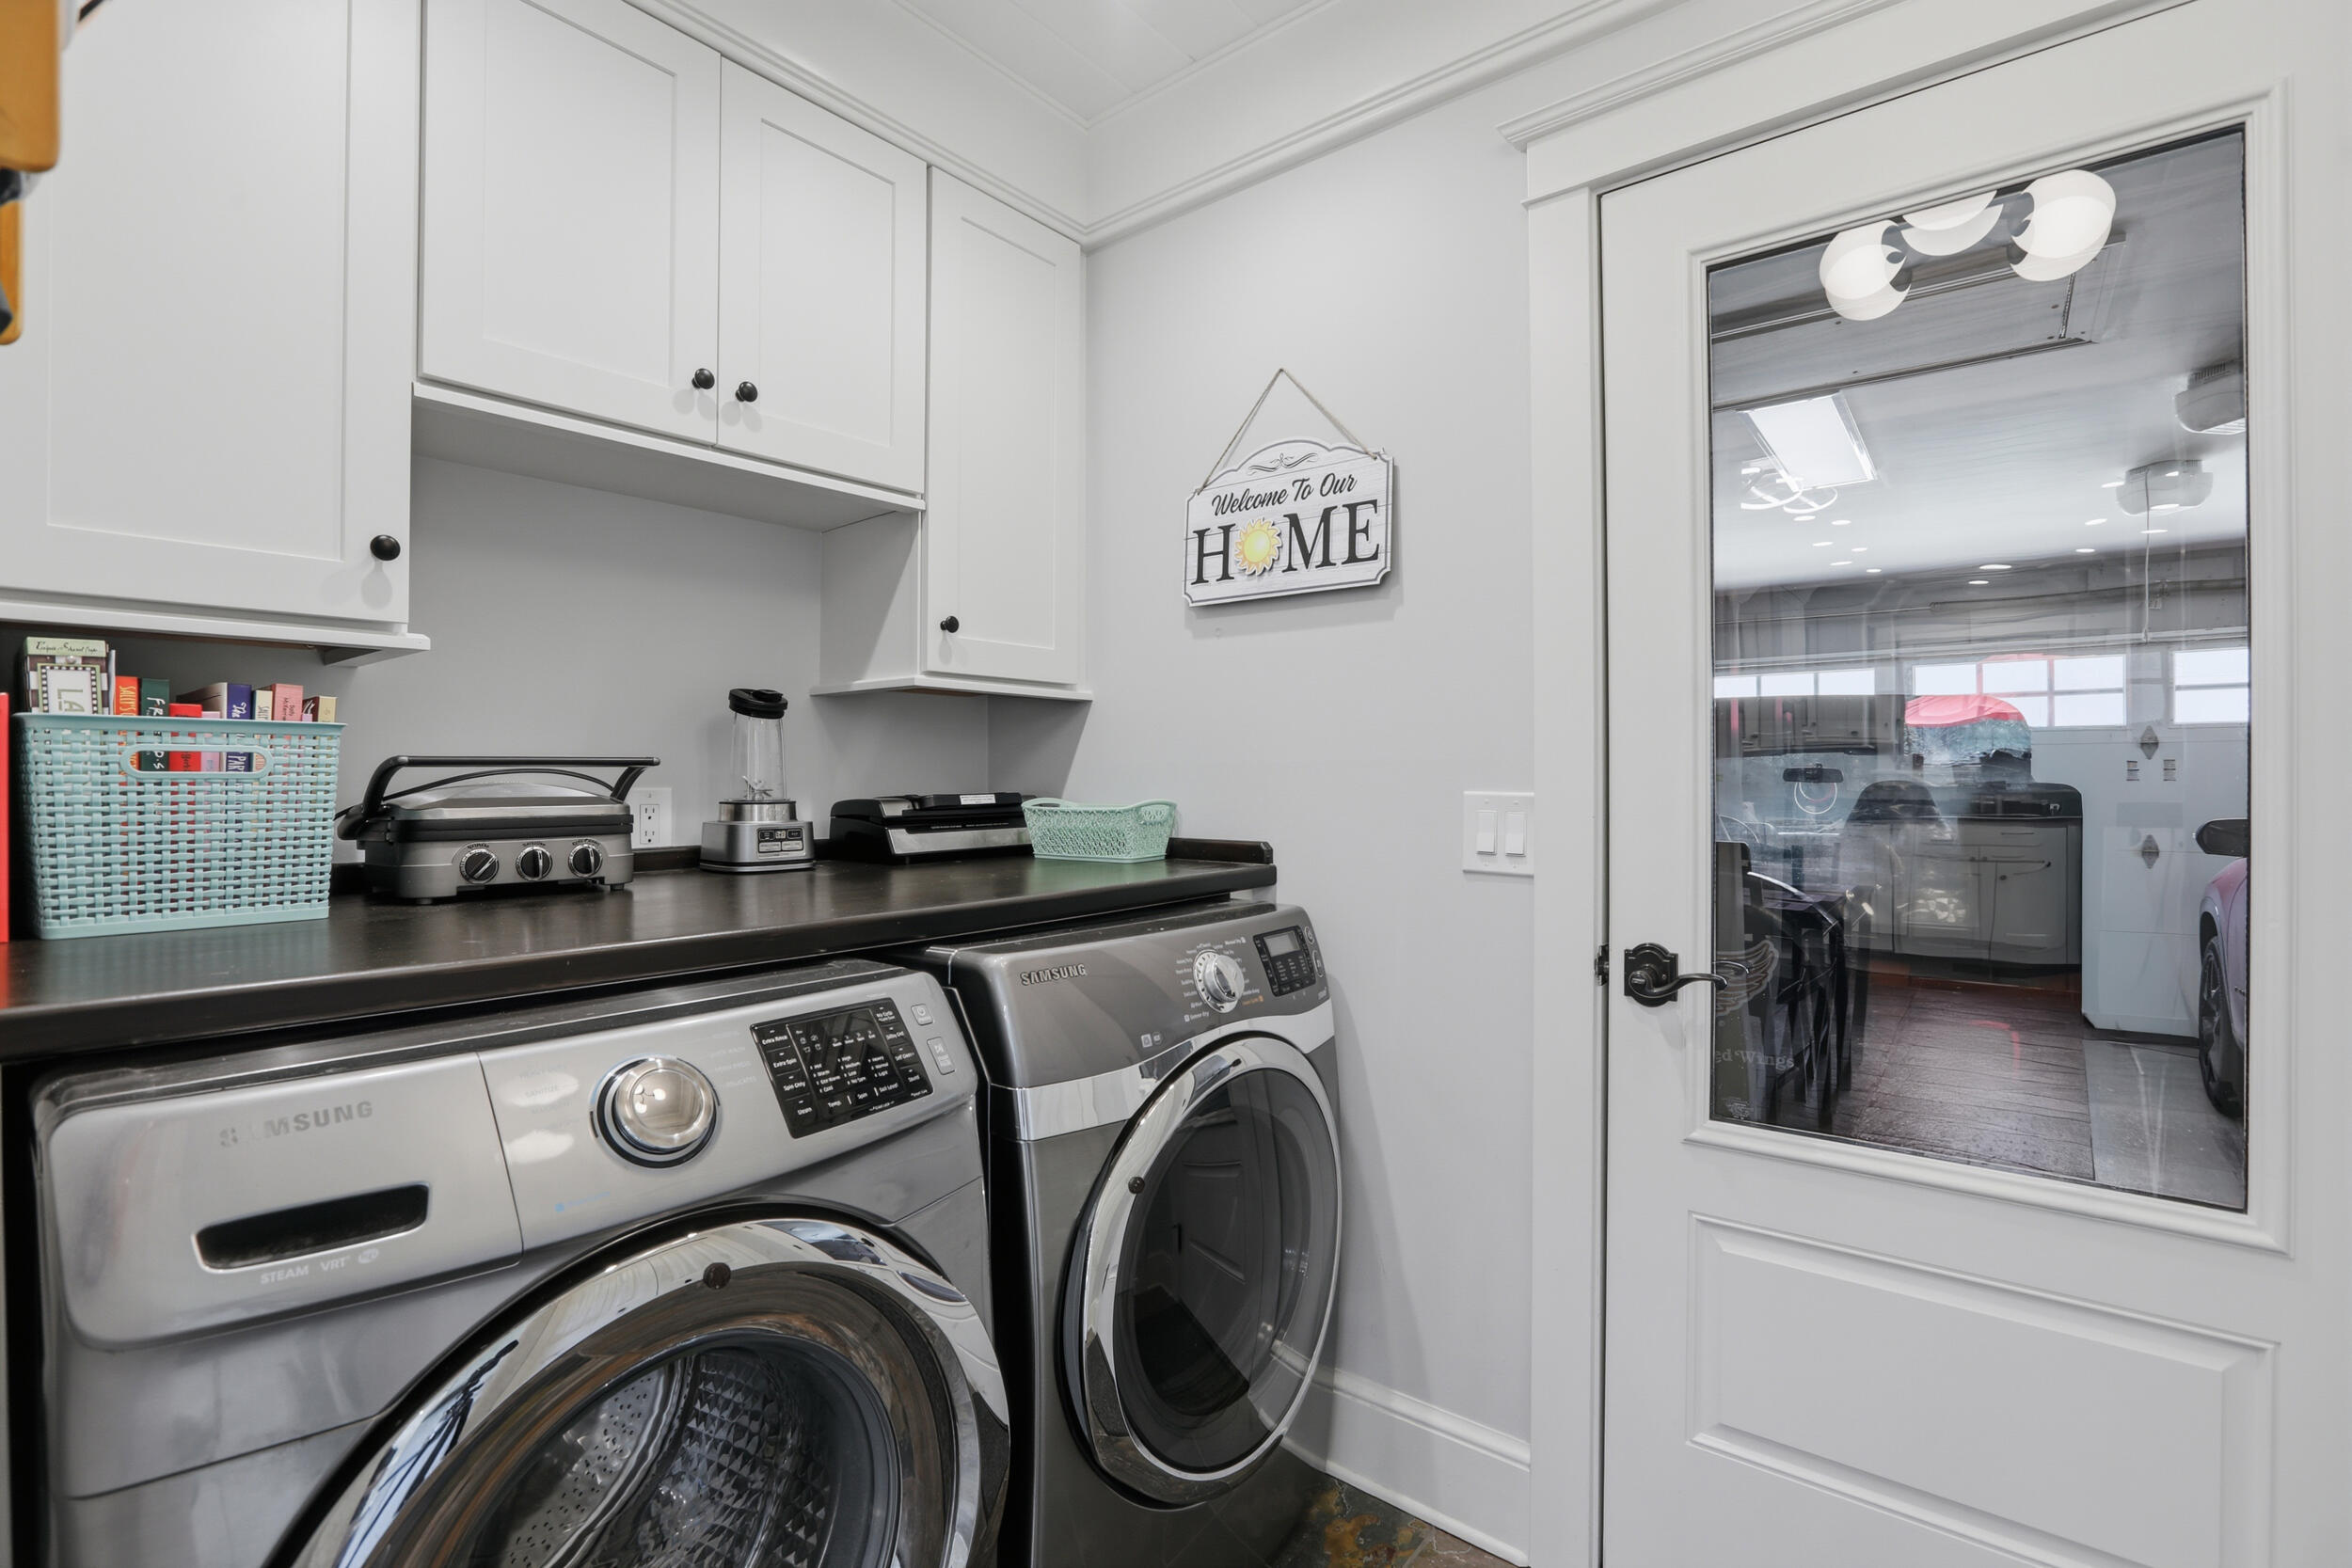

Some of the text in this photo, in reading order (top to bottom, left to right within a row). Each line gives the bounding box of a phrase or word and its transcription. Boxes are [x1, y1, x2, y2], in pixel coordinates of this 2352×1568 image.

[1212, 472, 1358, 516] Welcome To Our
[1021, 963, 1088, 986] SAMSUNG
[1735, 1051, 1794, 1073] Wings
[218, 1101, 373, 1148] SMSUNG
[260, 1265, 309, 1285] STEAM
